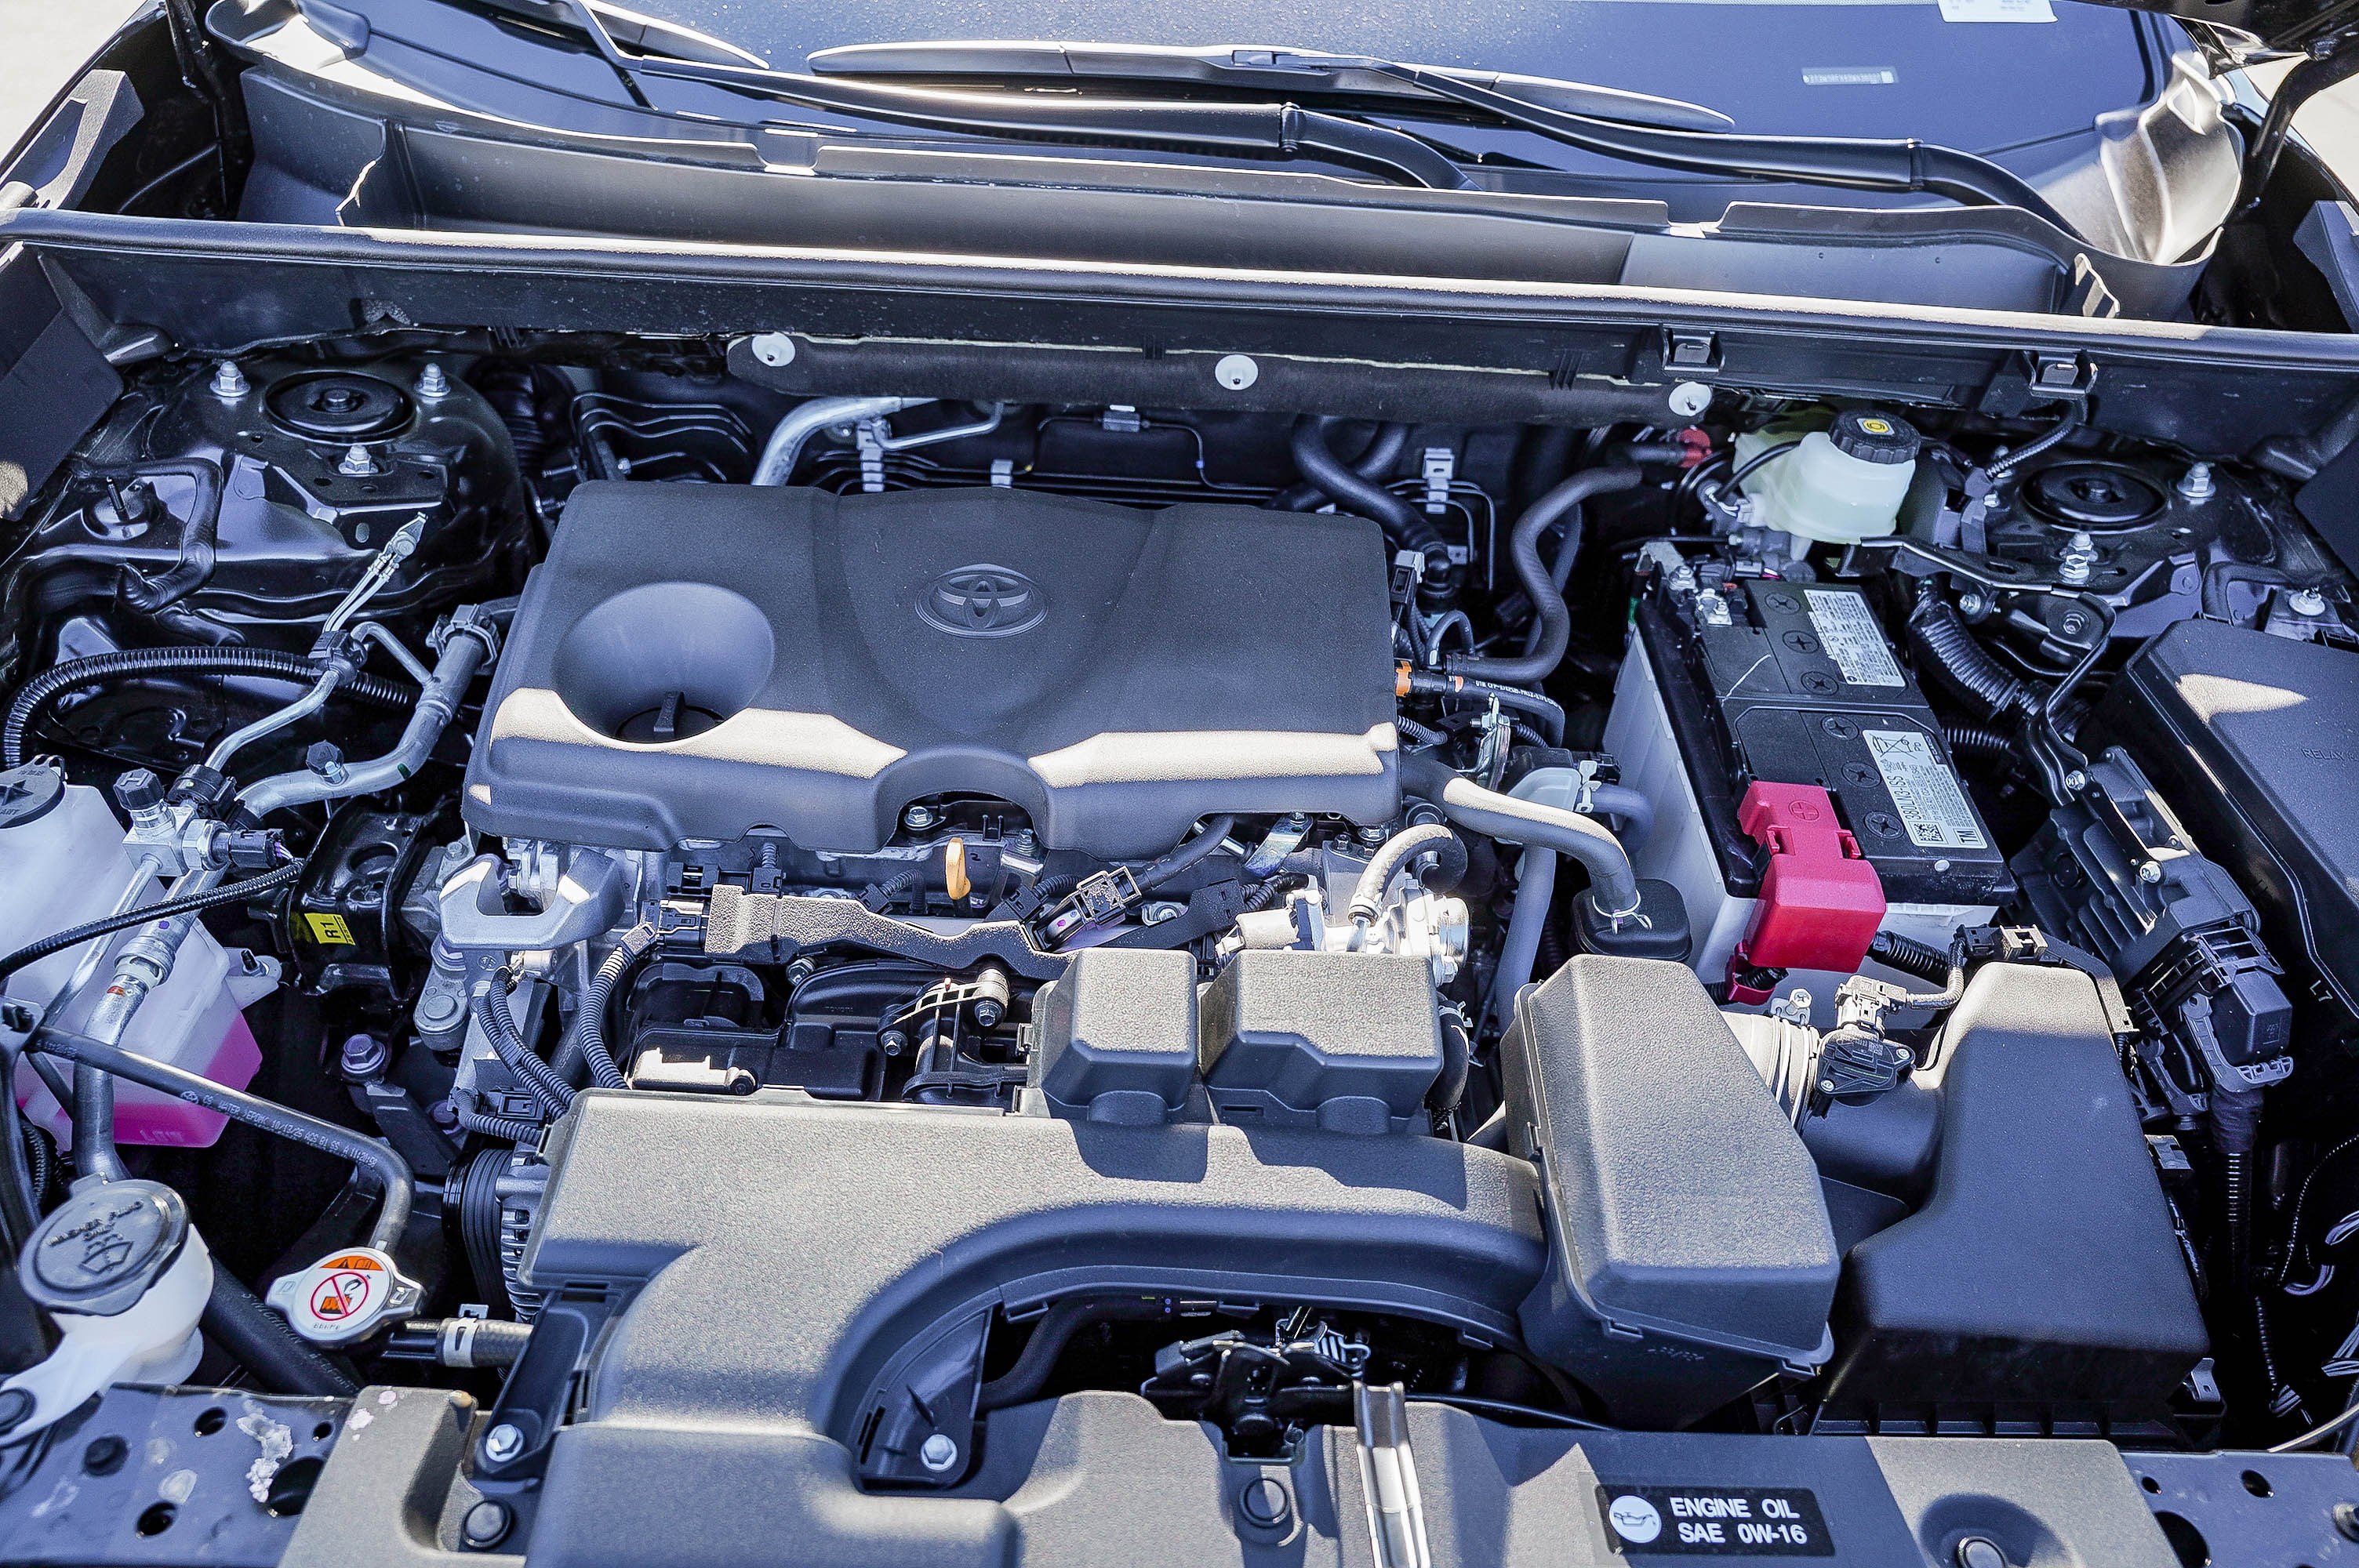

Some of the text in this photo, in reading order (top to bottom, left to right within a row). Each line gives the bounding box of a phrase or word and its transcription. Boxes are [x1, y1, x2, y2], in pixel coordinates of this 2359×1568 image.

[2300, 748, 2345, 761] RELAY
[120, 772, 149, 786] H
[1957, 830, 1979, 844] TM
[319, 921, 341, 939] R1
[218, 1100, 240, 1115] WATER
[1669, 1497, 1801, 1519] ENGINE OIL
[1678, 1522, 1808, 1544] SAE 0W-16
